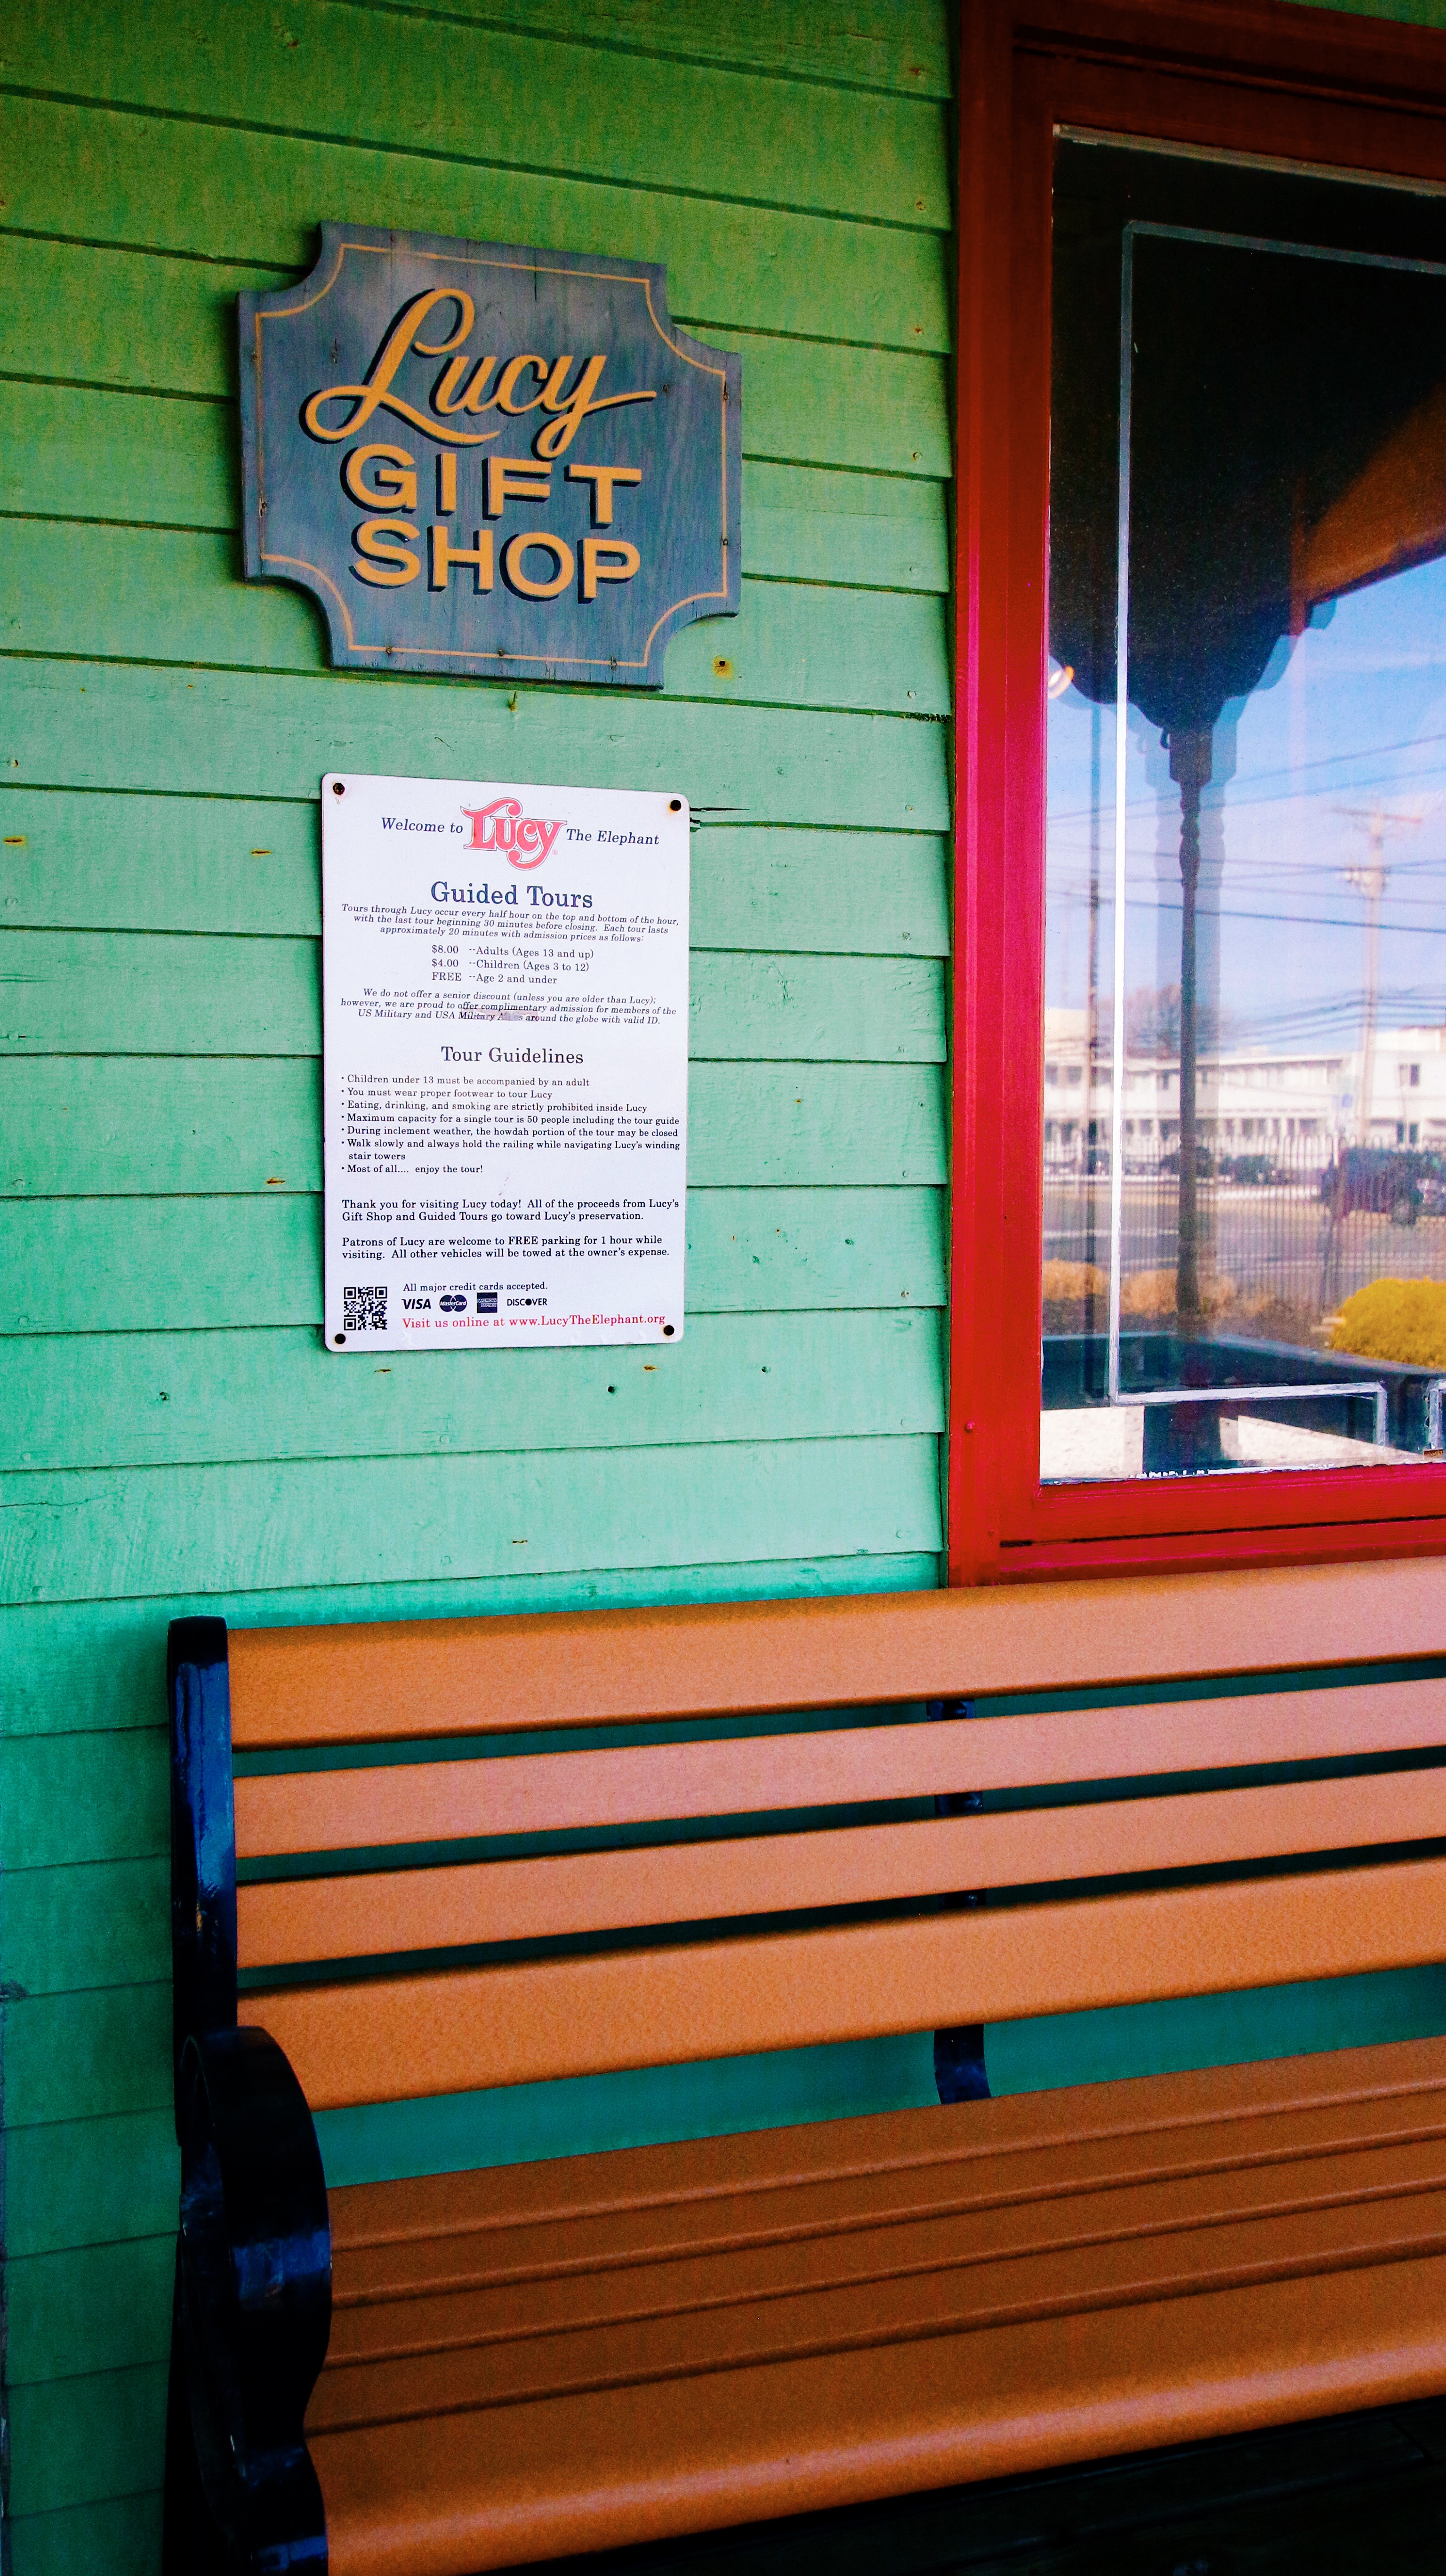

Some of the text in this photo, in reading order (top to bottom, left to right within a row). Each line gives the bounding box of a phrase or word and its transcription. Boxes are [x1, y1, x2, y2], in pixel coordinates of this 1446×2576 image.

[299, 288, 657, 460] Lucy
[340, 443, 642, 529] GIFT
[349, 519, 641, 603] SHOP
[381, 797, 659, 870] Welcome to Lucy The Elephant
[431, 881, 593, 909] Guided Tours
[341, 903, 368, 912] Tours
[371, 904, 407, 915] through
[410, 906, 433, 917] Lucy
[461, 911, 487, 919] every
[488, 910, 508, 918] half
[509, 910, 530, 919] hour
[546, 912, 560, 920] the
[562, 913, 576, 922] top
[578, 914, 595, 922] and
[597, 914, 627, 923] bottom
[641, 916, 654, 924] the
[656, 917, 679, 926] hour,
[380, 926, 446, 936] approximately
[448, 927, 459, 935] 20
[462, 928, 498, 937] minutes
[501, 930, 521, 938] with
[523, 930, 568, 940] admission
[570, 932, 596, 942] prices
[611, 934, 644, 942] follows:
[432, 944, 459, 954] $8.00
[512, 946, 539, 958] (Ages
[543, 949, 554, 957] 13
[557, 949, 575, 958] and
[578, 949, 594, 960] up)
[432, 958, 459, 968] $4.00
[523, 959, 550, 972] (Ages
[553, 962, 559, 971] 3
[562, 963, 571, 971] to
[575, 962, 589, 972] 12)
[432, 972, 462, 981] FREE
[498, 974, 504, 982] 2
[507, 974, 525, 983] and
[528, 975, 557, 984] under
[363, 988, 377, 997] We
[380, 989, 391, 997] do
[410, 990, 433, 998] offer
[442, 991, 471, 999] senior
[473, 991, 511, 1000] discount
[514, 992, 545, 1001] (unless
[582, 995, 604, 1003] older
[607, 995, 627, 1004] than
[629, 996, 656, 1006] Lucy);
[441, 1046, 584, 1064] Tour Guidelines
[347, 1074, 389, 1083] Children
[392, 1075, 420, 1084] under
[423, 1076, 434, 1084] 13
[463, 1076, 474, 1085] be
[477, 1077, 536, 1087] accompanied
[538, 1077, 549, 1087] by
[566, 1078, 590, 1087] adult
[347, 1100, 382, 1111] Eating,
[385, 1100, 428, 1111] drinking,
[432, 1101, 449, 1110] and
[452, 1102, 491, 1112] smoking
[512, 1102, 544, 1112] strictly
[546, 1103, 594, 1112] prohibited
[596, 1103, 623, 1111] inside
[626, 1103, 648, 1114] Lucy
[347, 1126, 381, 1136] During
[384, 1126, 431, 1135] inclement
[433, 1127, 473, 1136] weather,
[476, 1127, 491, 1135] the
[494, 1127, 529, 1135] howdah
[532, 1127, 565, 1137] portion
[567, 1127, 577, 1136] of
[578, 1128, 593, 1136] the
[617, 1130, 636, 1138] may
[639, 1128, 649, 1136] be
[651, 1128, 678, 1137] closed
[347, 1164, 483, 1175] Most of all.... enjoy the tour!
[342, 1199, 679, 1210] Thank you for visiting Lucy today! All of the proceeds from Lucy's
[342, 1237, 384, 1247] Patrons
[386, 1237, 398, 1246] of
[400, 1237, 426, 1248] Lucy
[448, 1236, 492, 1246] welcome
[494, 1237, 505, 1245] to
[508, 1236, 538, 1245] FREE
[541, 1236, 581, 1247] parking
[583, 1235, 598, 1245] for
[601, 1236, 606, 1244] 1
[609, 1235, 633, 1244] hour
[635, 1235, 662, 1244] while
[342, 1247, 669, 1261] visiting. All other vehicles will be towed at the owner's expense.
[402, 1281, 548, 1293] All major credit cards accepted.
[402, 1298, 431, 1309] VISA
[506, 1298, 547, 1306] DISCOVER
[402, 1318, 431, 1328] Visit
[452, 1317, 489, 1327] online
[493, 1317, 505, 1327] at
[509, 1313, 666, 1327] www.LucyTheElephant.org
